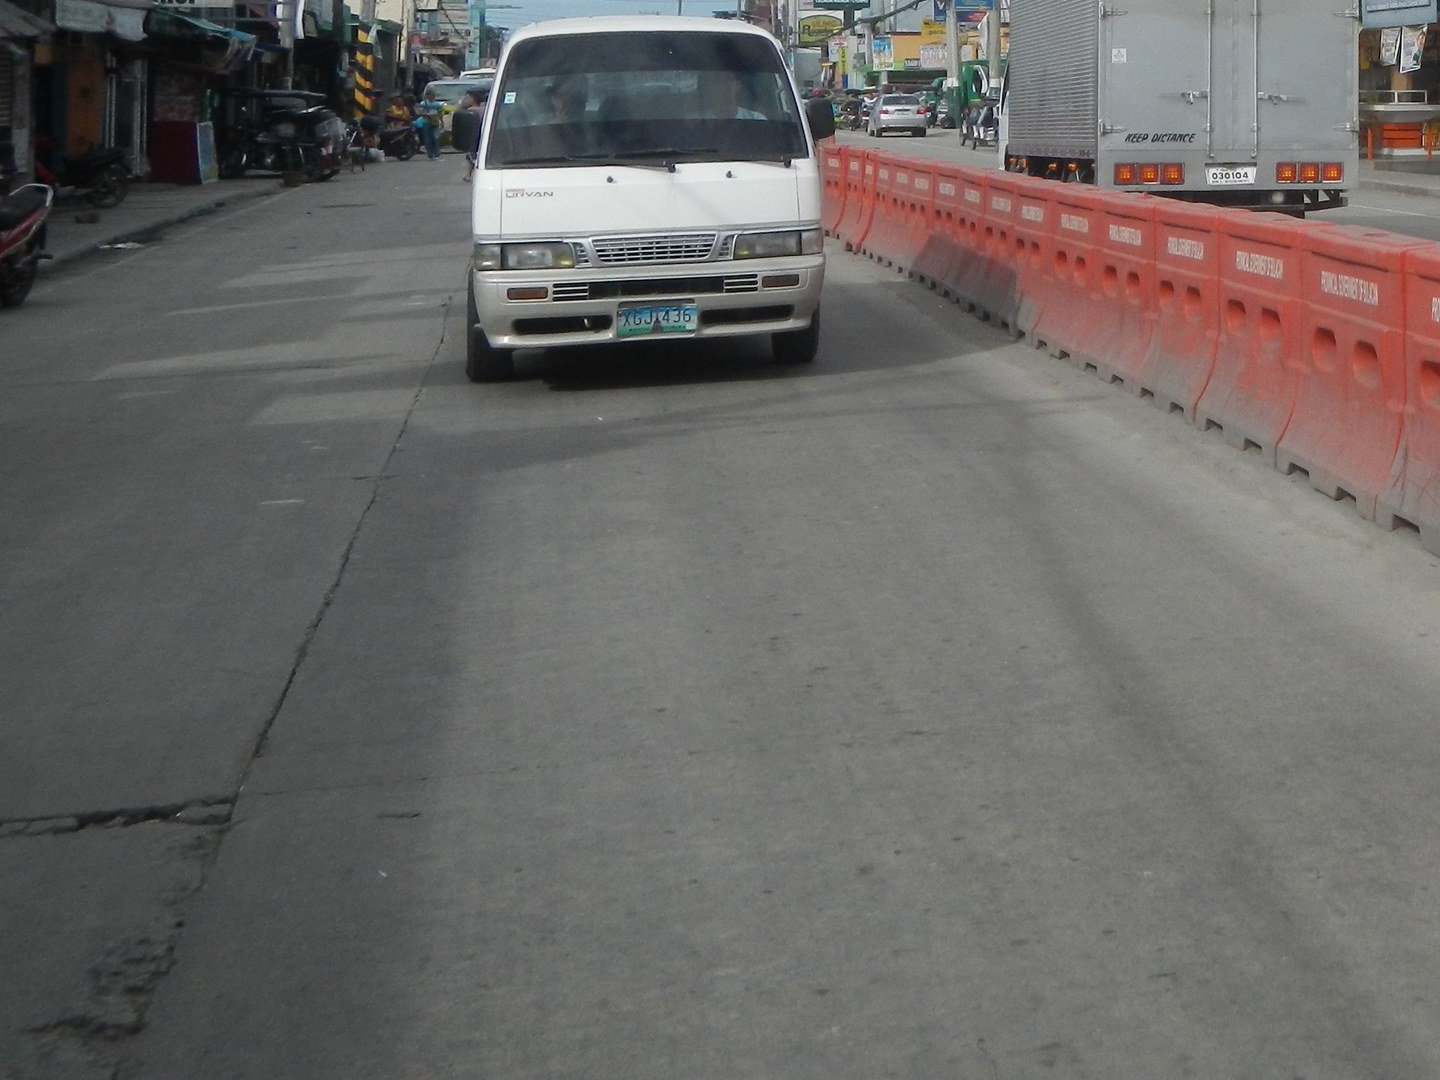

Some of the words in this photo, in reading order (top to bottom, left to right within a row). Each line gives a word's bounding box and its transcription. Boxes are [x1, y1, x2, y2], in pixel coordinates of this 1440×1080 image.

[1125, 133, 1149, 143] KEEP
[1211, 171, 1249, 180] 030104
[662, 308, 692, 323] 436
